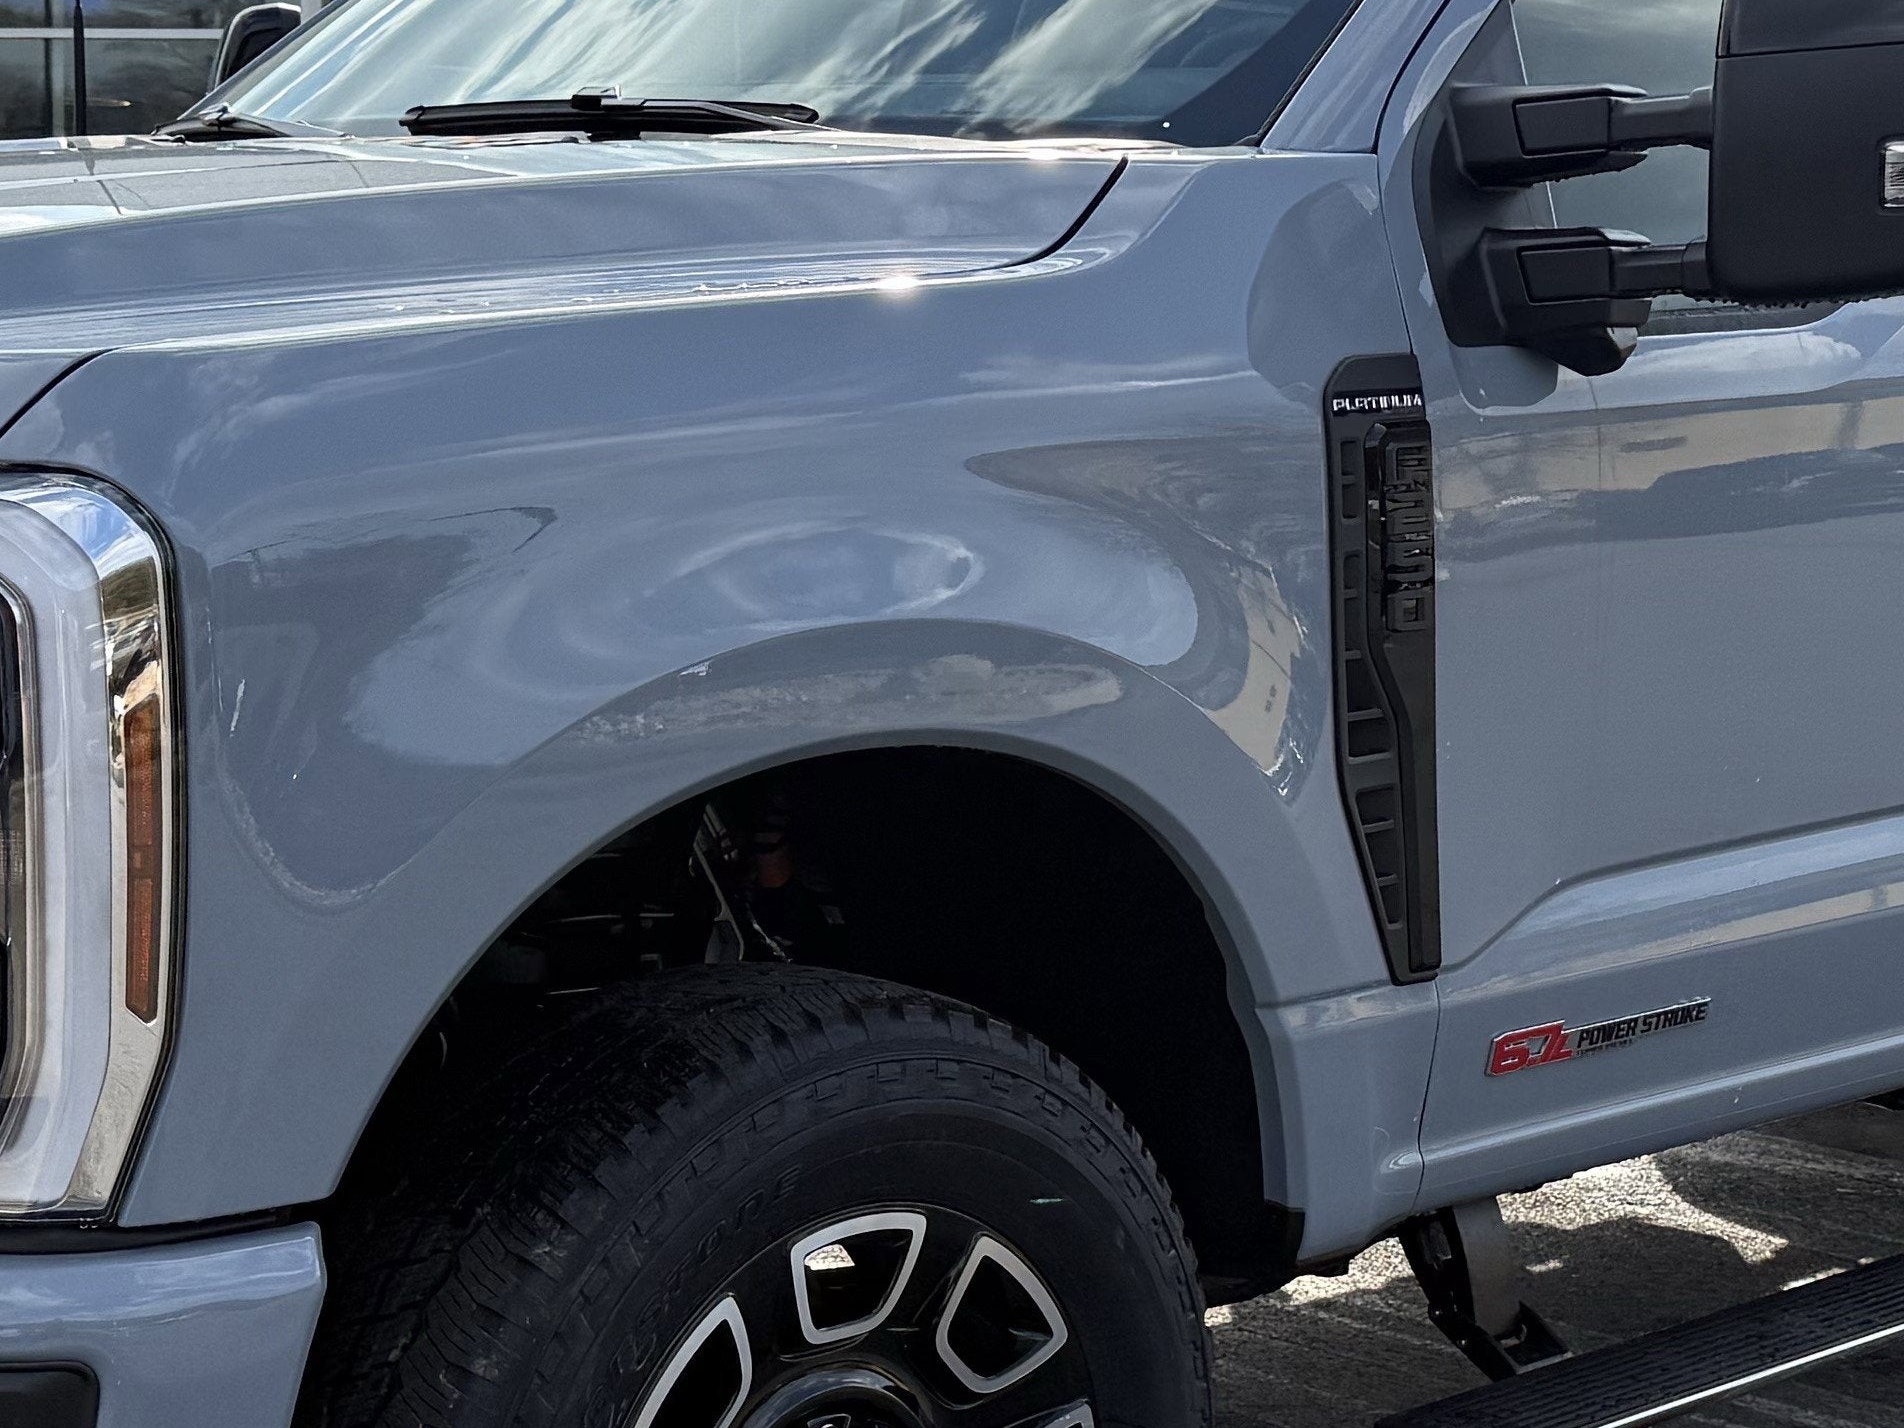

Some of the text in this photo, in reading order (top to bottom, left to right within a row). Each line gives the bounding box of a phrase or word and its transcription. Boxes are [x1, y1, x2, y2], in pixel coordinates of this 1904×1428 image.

[1332, 393, 1422, 411] PLATINUM
[1576, 1019, 1638, 1049] POWER
[1640, 1002, 1709, 1034] STROKE
